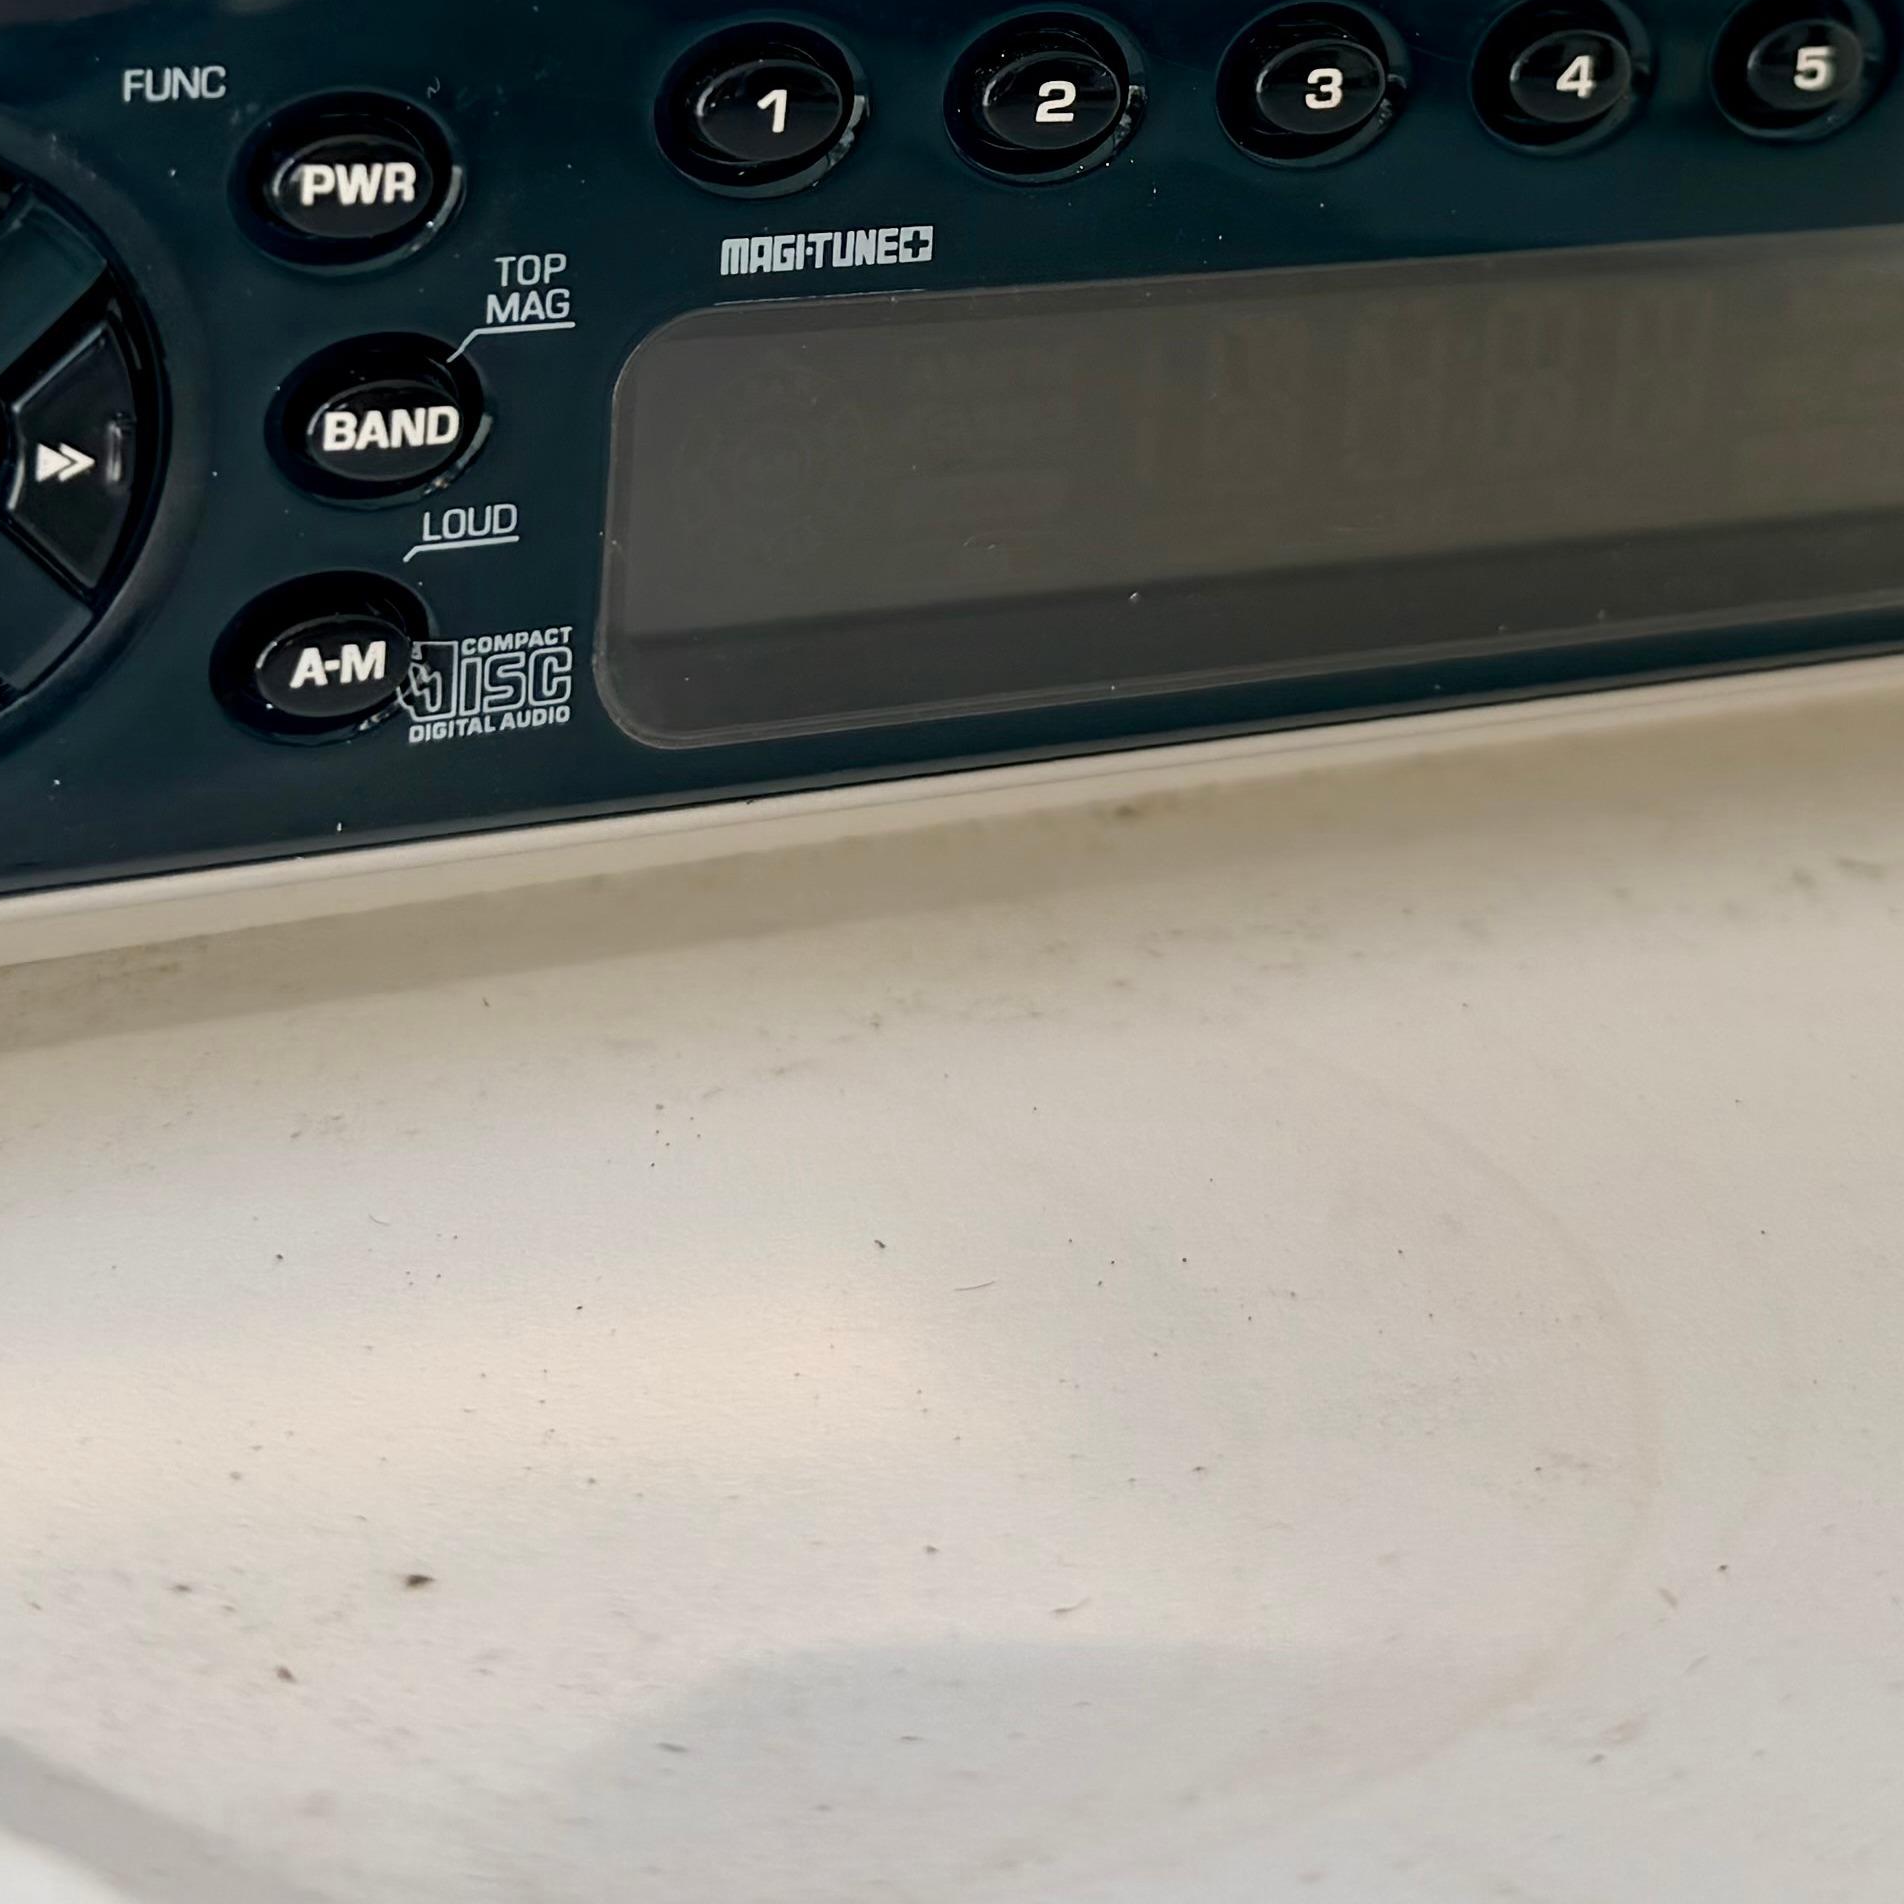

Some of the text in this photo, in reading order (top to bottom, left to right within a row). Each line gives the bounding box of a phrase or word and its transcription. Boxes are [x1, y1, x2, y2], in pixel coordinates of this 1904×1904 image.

[122, 65, 228, 102] FUNC
[1304, 67, 1344, 109] 3
[1556, 55, 1593, 97] 4
[1793, 46, 1836, 90] 5
[757, 88, 789, 133] 1
[1034, 80, 1077, 123] 2
[299, 162, 417, 207] PWR
[496, 253, 568, 287] TOP
[485, 290, 571, 325] MAG
[321, 406, 460, 452] BAND
[422, 504, 518, 542] LOUD
[460, 626, 573, 656] COMPACT
[289, 641, 387, 689] A-M
[408, 705, 571, 744] DIGITAL AUDIO
